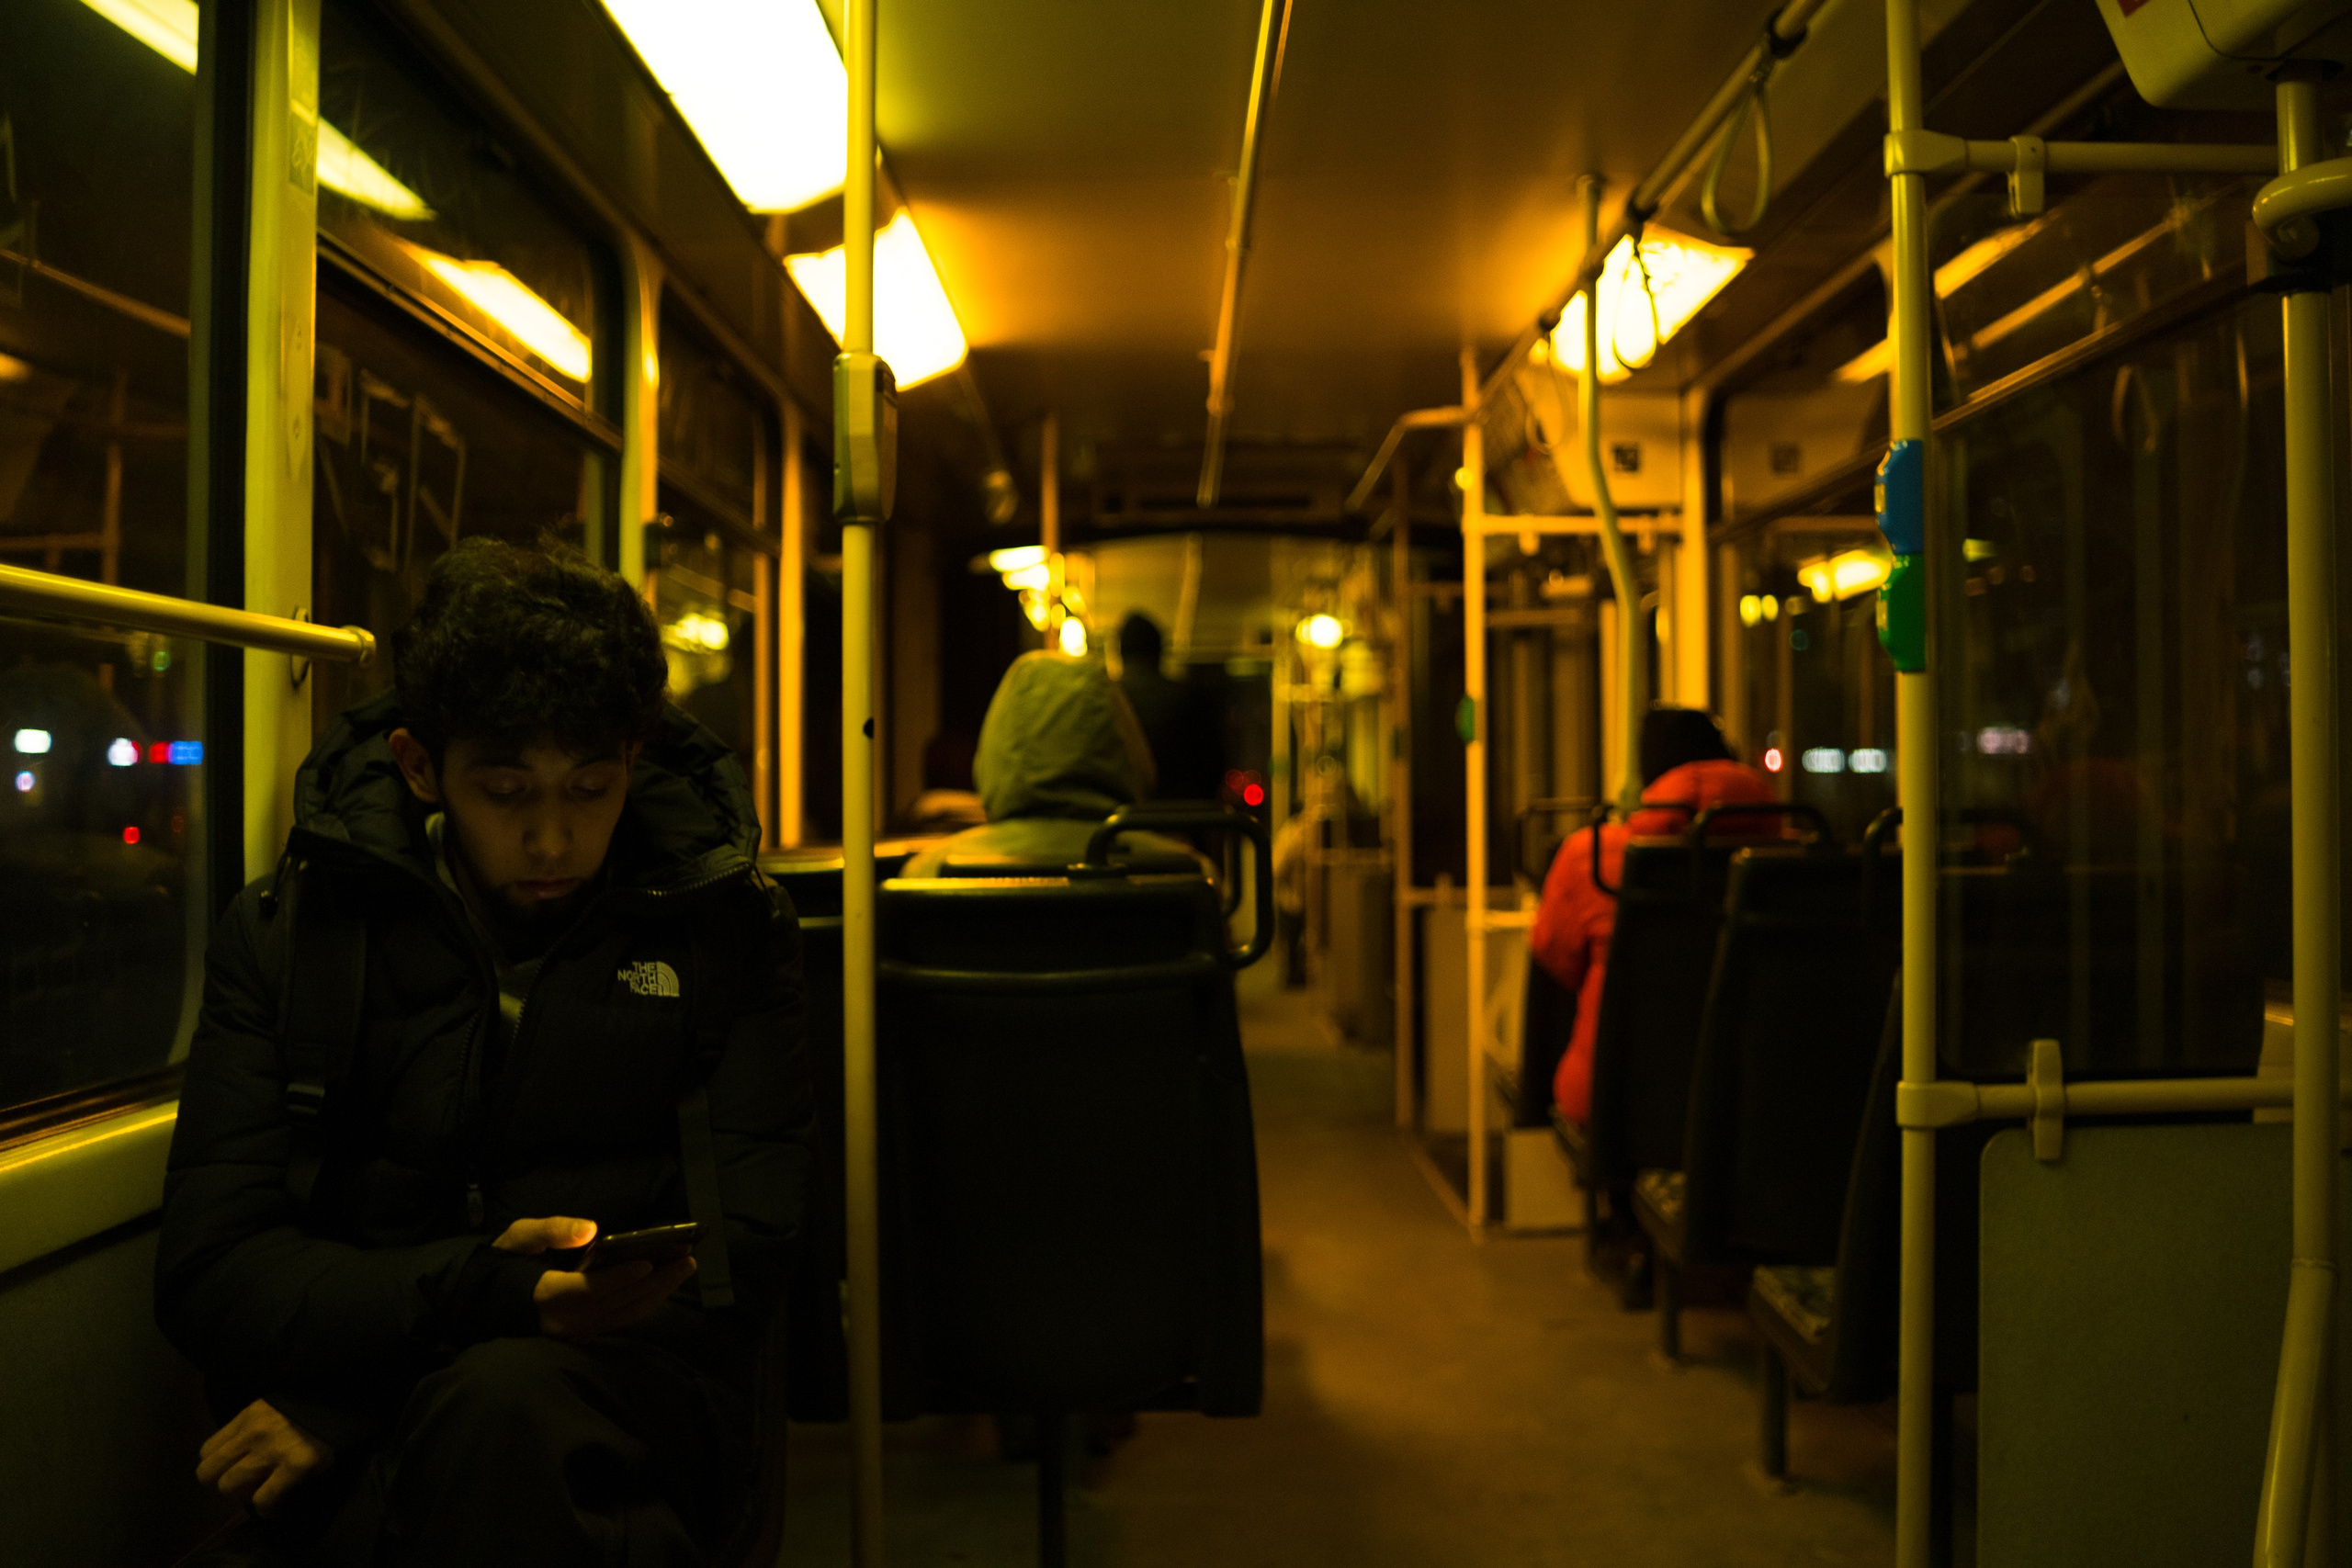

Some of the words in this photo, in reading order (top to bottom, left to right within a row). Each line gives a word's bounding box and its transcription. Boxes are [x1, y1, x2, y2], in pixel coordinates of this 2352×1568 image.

[632, 961, 656, 973] THE
[617, 969, 657, 984] NORTH
[629, 980, 657, 995] FACE
